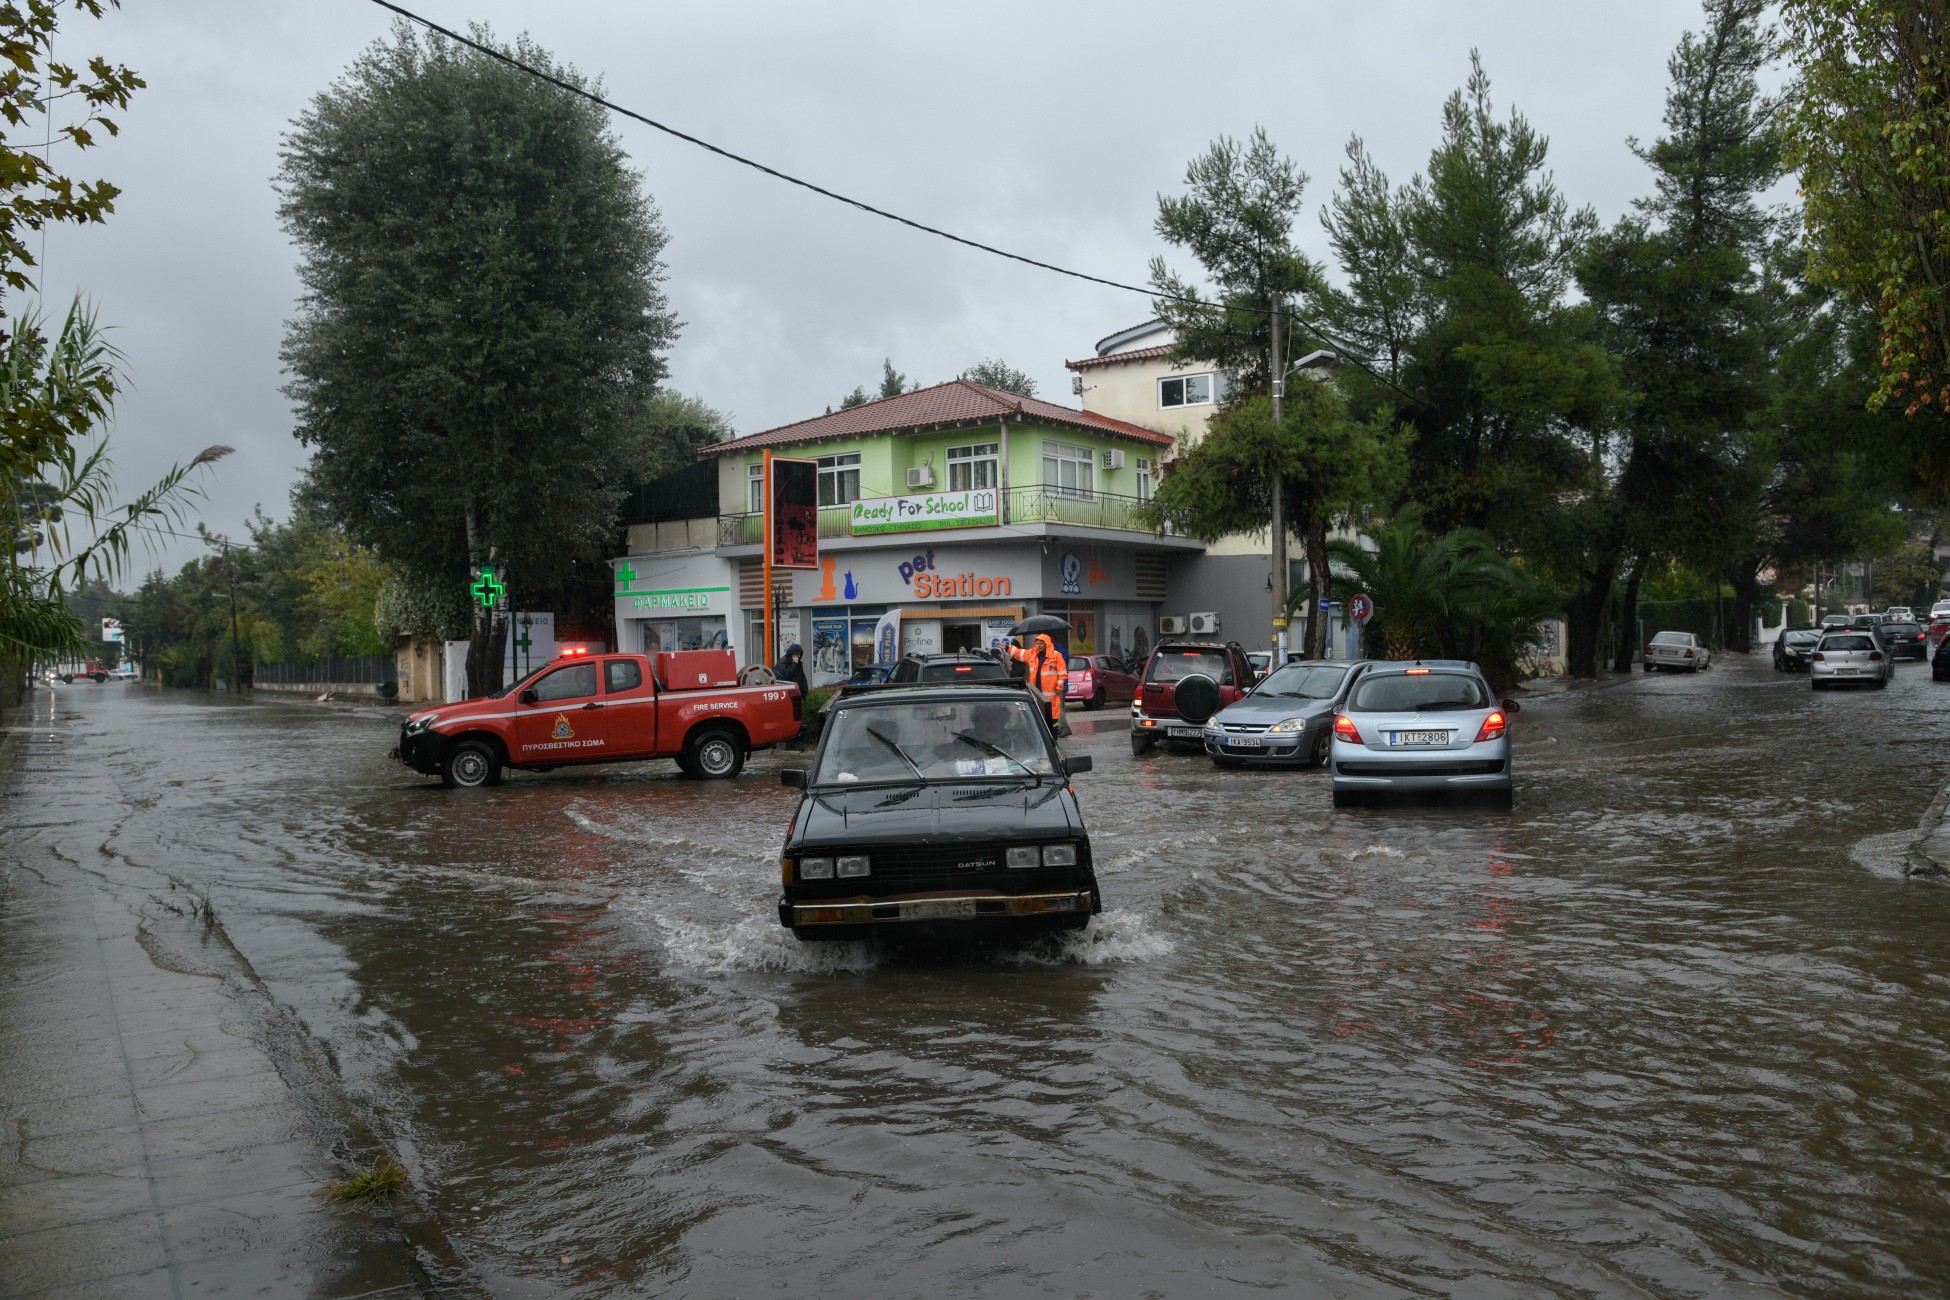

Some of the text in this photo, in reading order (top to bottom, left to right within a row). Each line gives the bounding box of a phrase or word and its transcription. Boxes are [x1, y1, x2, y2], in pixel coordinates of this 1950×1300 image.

[853, 493, 969, 522] Ready For School
[898, 549, 935, 585] pet
[913, 572, 1010, 598] Station
[634, 594, 709, 609] ΦΑΡΜΑΚΕΙΟ
[903, 637, 932, 646] Profine
[763, 692, 779, 701] 199
[694, 703, 708, 711] FIRE
[522, 739, 604, 751] ΠΥΡΟΣΒΕΣΤΙΚΟ ΣΩΜΑ
[958, 860, 996, 868] DATSUN
